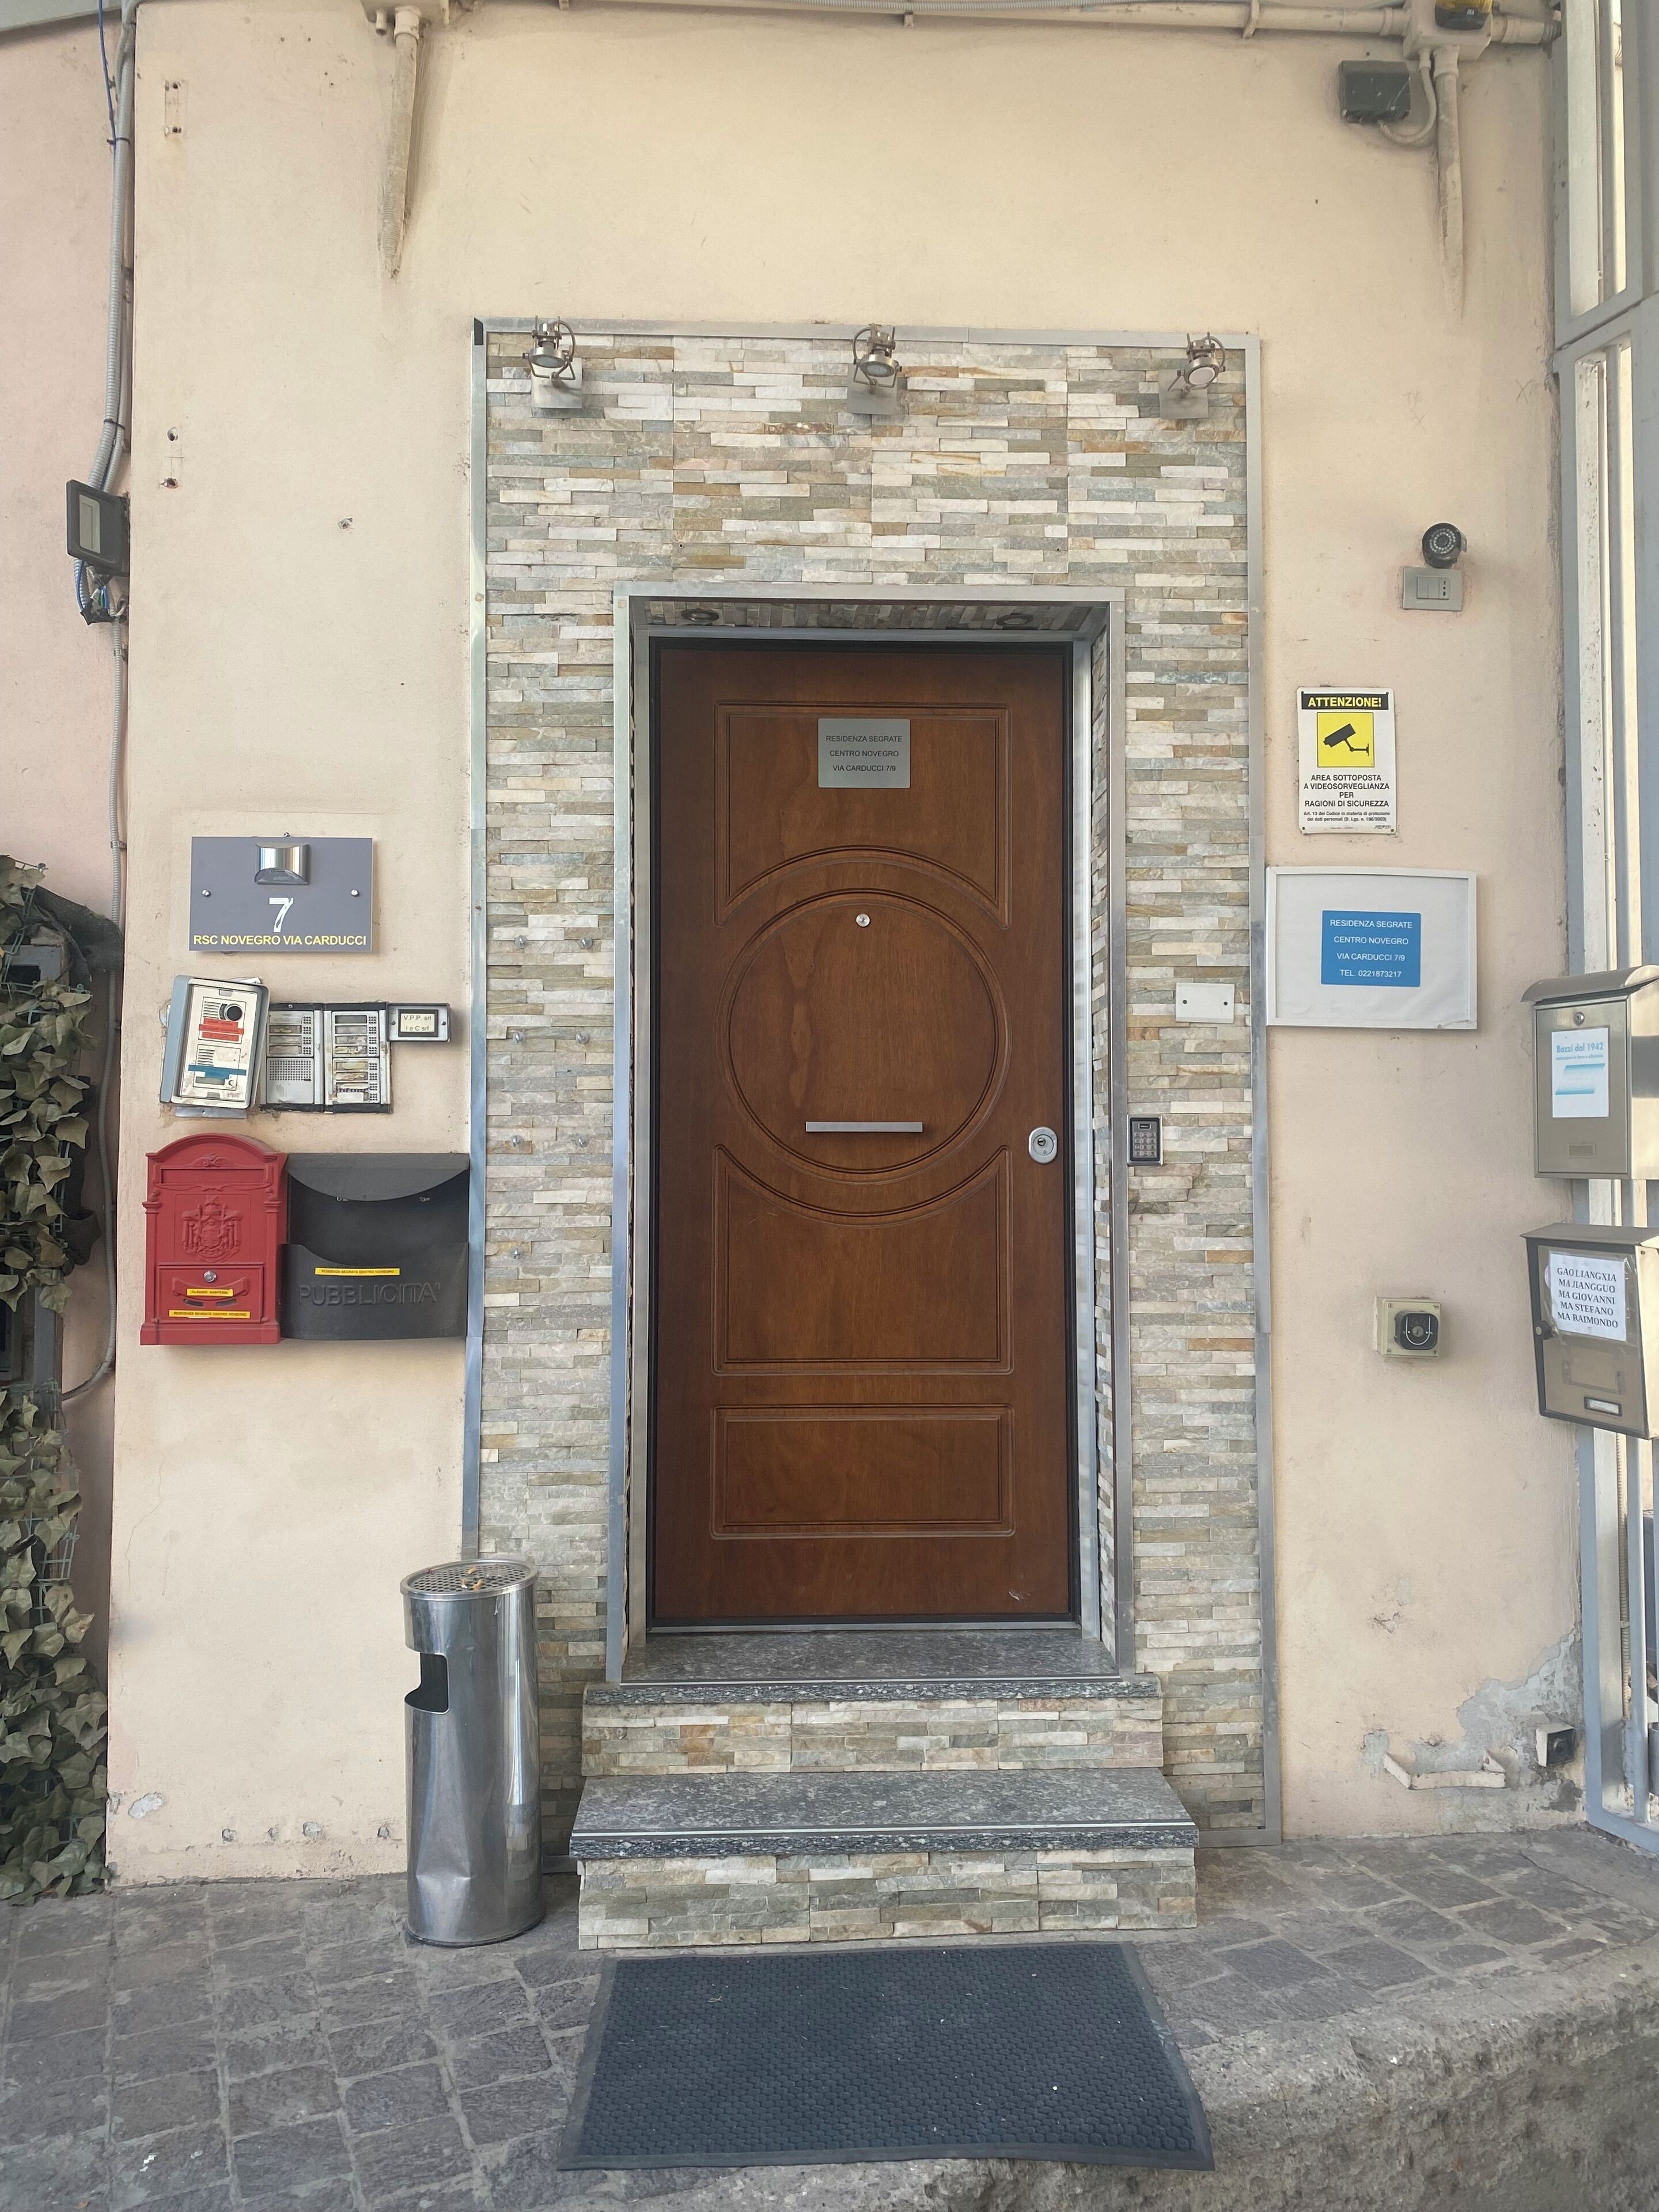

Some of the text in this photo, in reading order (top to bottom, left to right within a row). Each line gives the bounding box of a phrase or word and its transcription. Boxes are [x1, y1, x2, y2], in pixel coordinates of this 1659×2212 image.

[1308, 696, 1382, 707] ATTENZIONE!
[268, 897, 294, 933] 7
[1330, 919, 1413, 929] RESIDENZA SEGRATE
[193, 935, 366, 945] RSC NOVEGRO VIA CARDUCCI
[1334, 935, 1409, 945] CENTRO NOVEGRO
[1556, 1042, 1604, 1053] Bazzi dal 1942
[1557, 1267, 1617, 1282] GAO LIANGXIA
[1558, 1278, 1616, 1293] MA JIANGGUO
[298, 1282, 441, 1306] PUBBLICITA'
[1558, 1290, 1615, 1305] MA GIOVANNI
[1560, 1301, 1613, 1316] MA STEFANO
[1557, 1312, 1618, 1328] MA RAIMONDO
